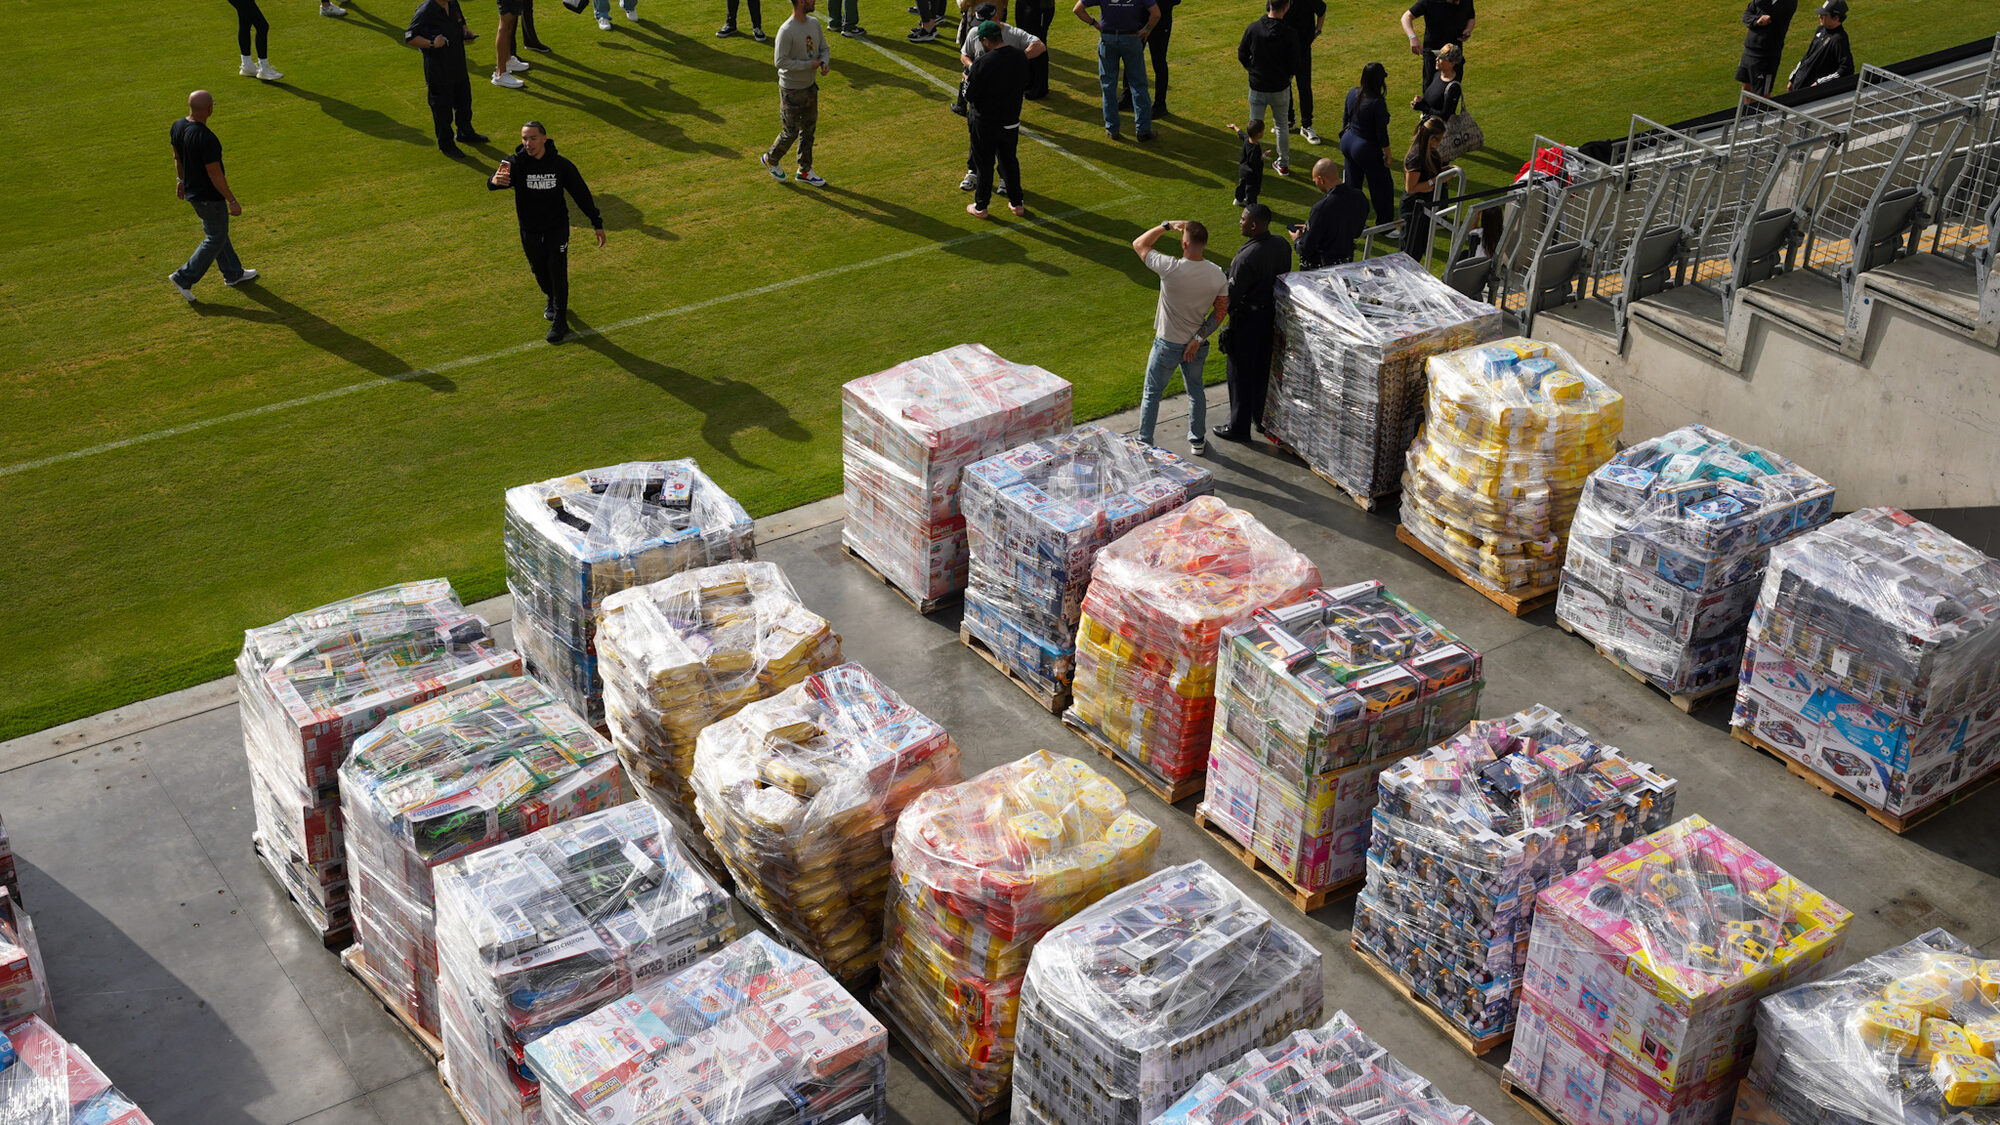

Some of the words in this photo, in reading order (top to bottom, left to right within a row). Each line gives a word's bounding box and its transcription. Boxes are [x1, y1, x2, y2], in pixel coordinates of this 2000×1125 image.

[526, 180, 557, 190] GAMES
[502, 779, 536, 810] SUBWAY
[534, 943, 560, 958] BUGATTI
[635, 963, 664, 979] WARS
[584, 1077, 618, 1100] TOP-NOTCH
